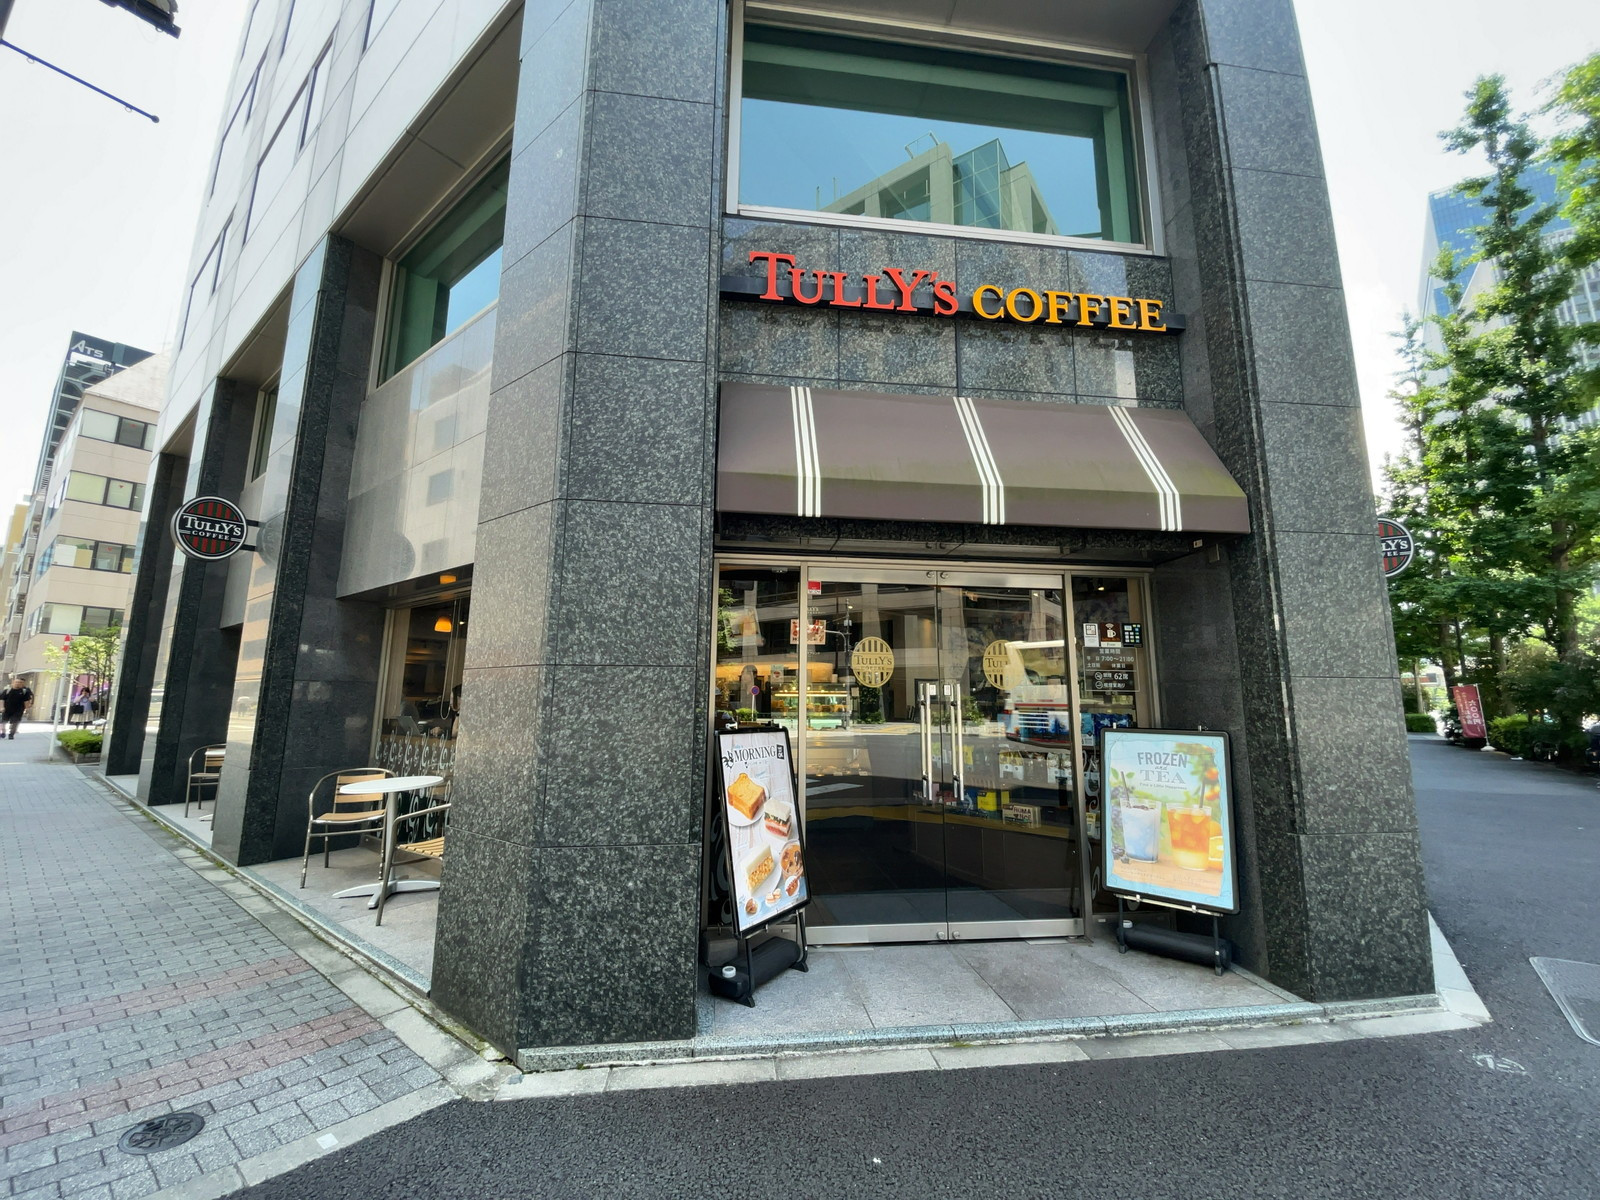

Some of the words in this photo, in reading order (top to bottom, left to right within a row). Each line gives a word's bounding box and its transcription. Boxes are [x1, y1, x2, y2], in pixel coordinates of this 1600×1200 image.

[749, 251, 960, 316] TULLY'S
[972, 284, 1168, 333] COFFEE
[70, 339, 104, 358] ATS
[183, 515, 242, 536] TULLY'S
[192, 530, 230, 541] COFFEE
[734, 745, 776, 763] MORNING
[1137, 751, 1188, 769] FROZEN
[1139, 769, 1186, 785] TEA
